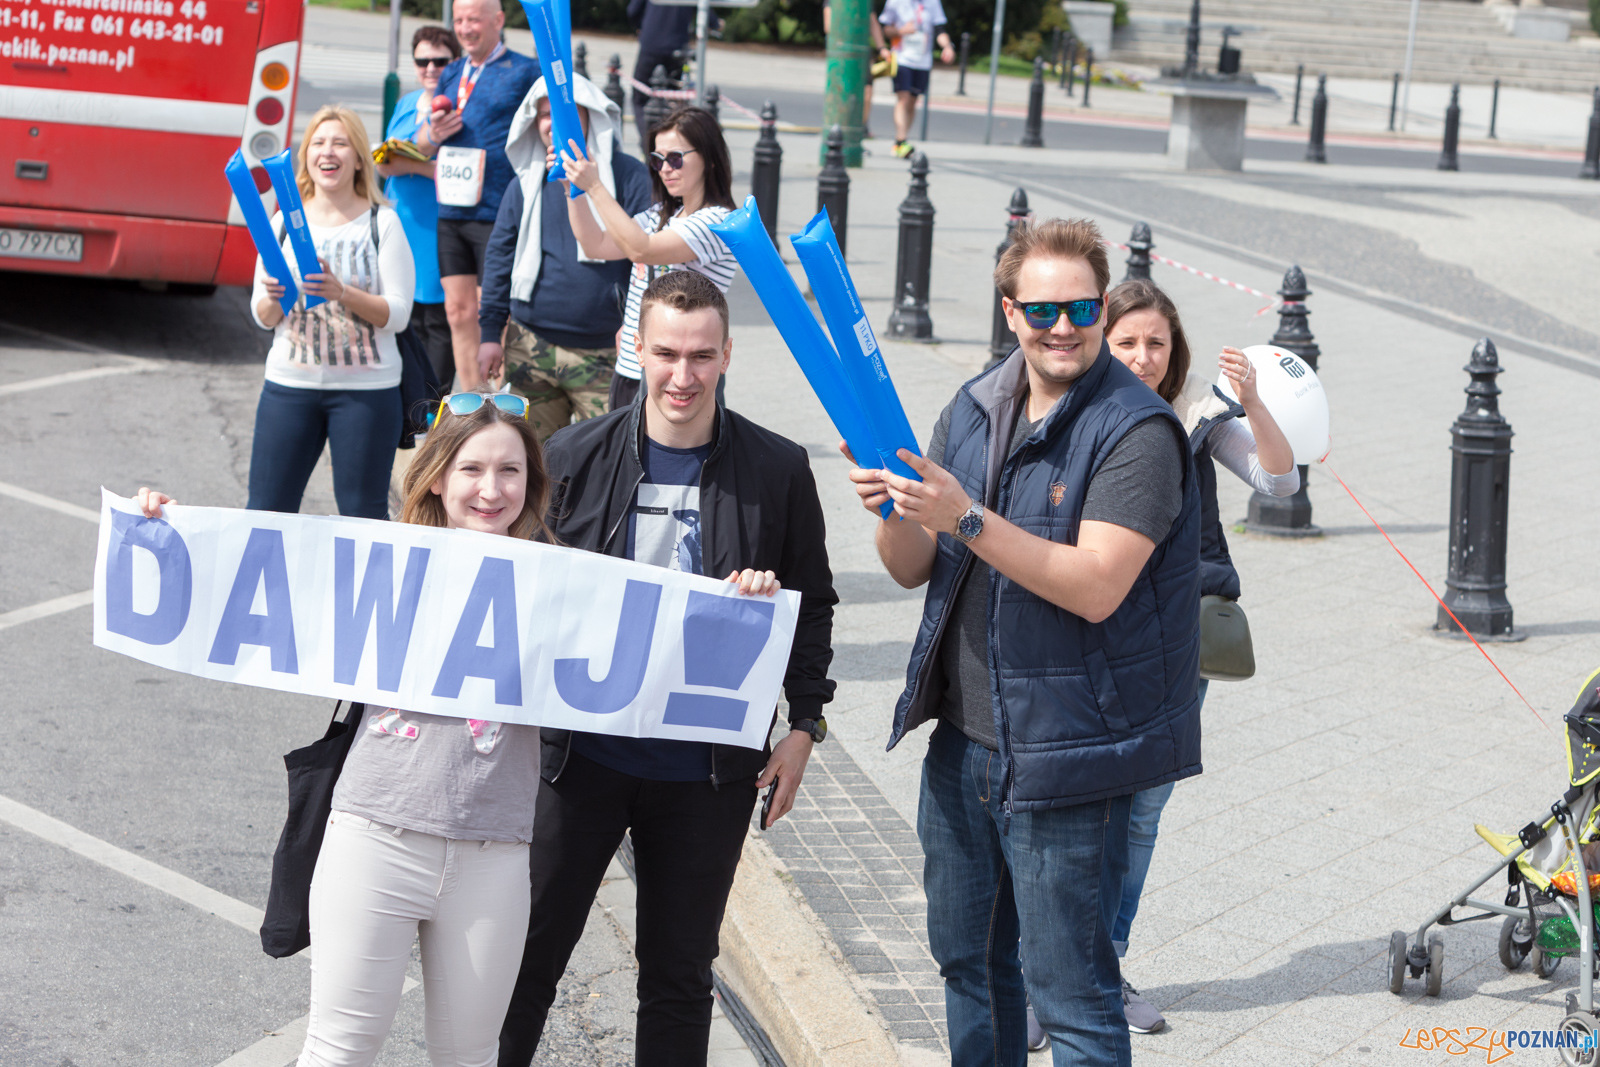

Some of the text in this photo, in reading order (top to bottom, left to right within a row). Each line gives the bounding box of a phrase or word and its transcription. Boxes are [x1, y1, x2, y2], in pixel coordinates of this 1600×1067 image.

[0, 7, 223, 46] 1-11, Fax 061 643-21-01
[180, 0, 207, 20] 44
[19, 231, 78, 256] 797CX
[105, 506, 775, 732] DAWAJ!
[1571, 857, 1584, 892] Joker
